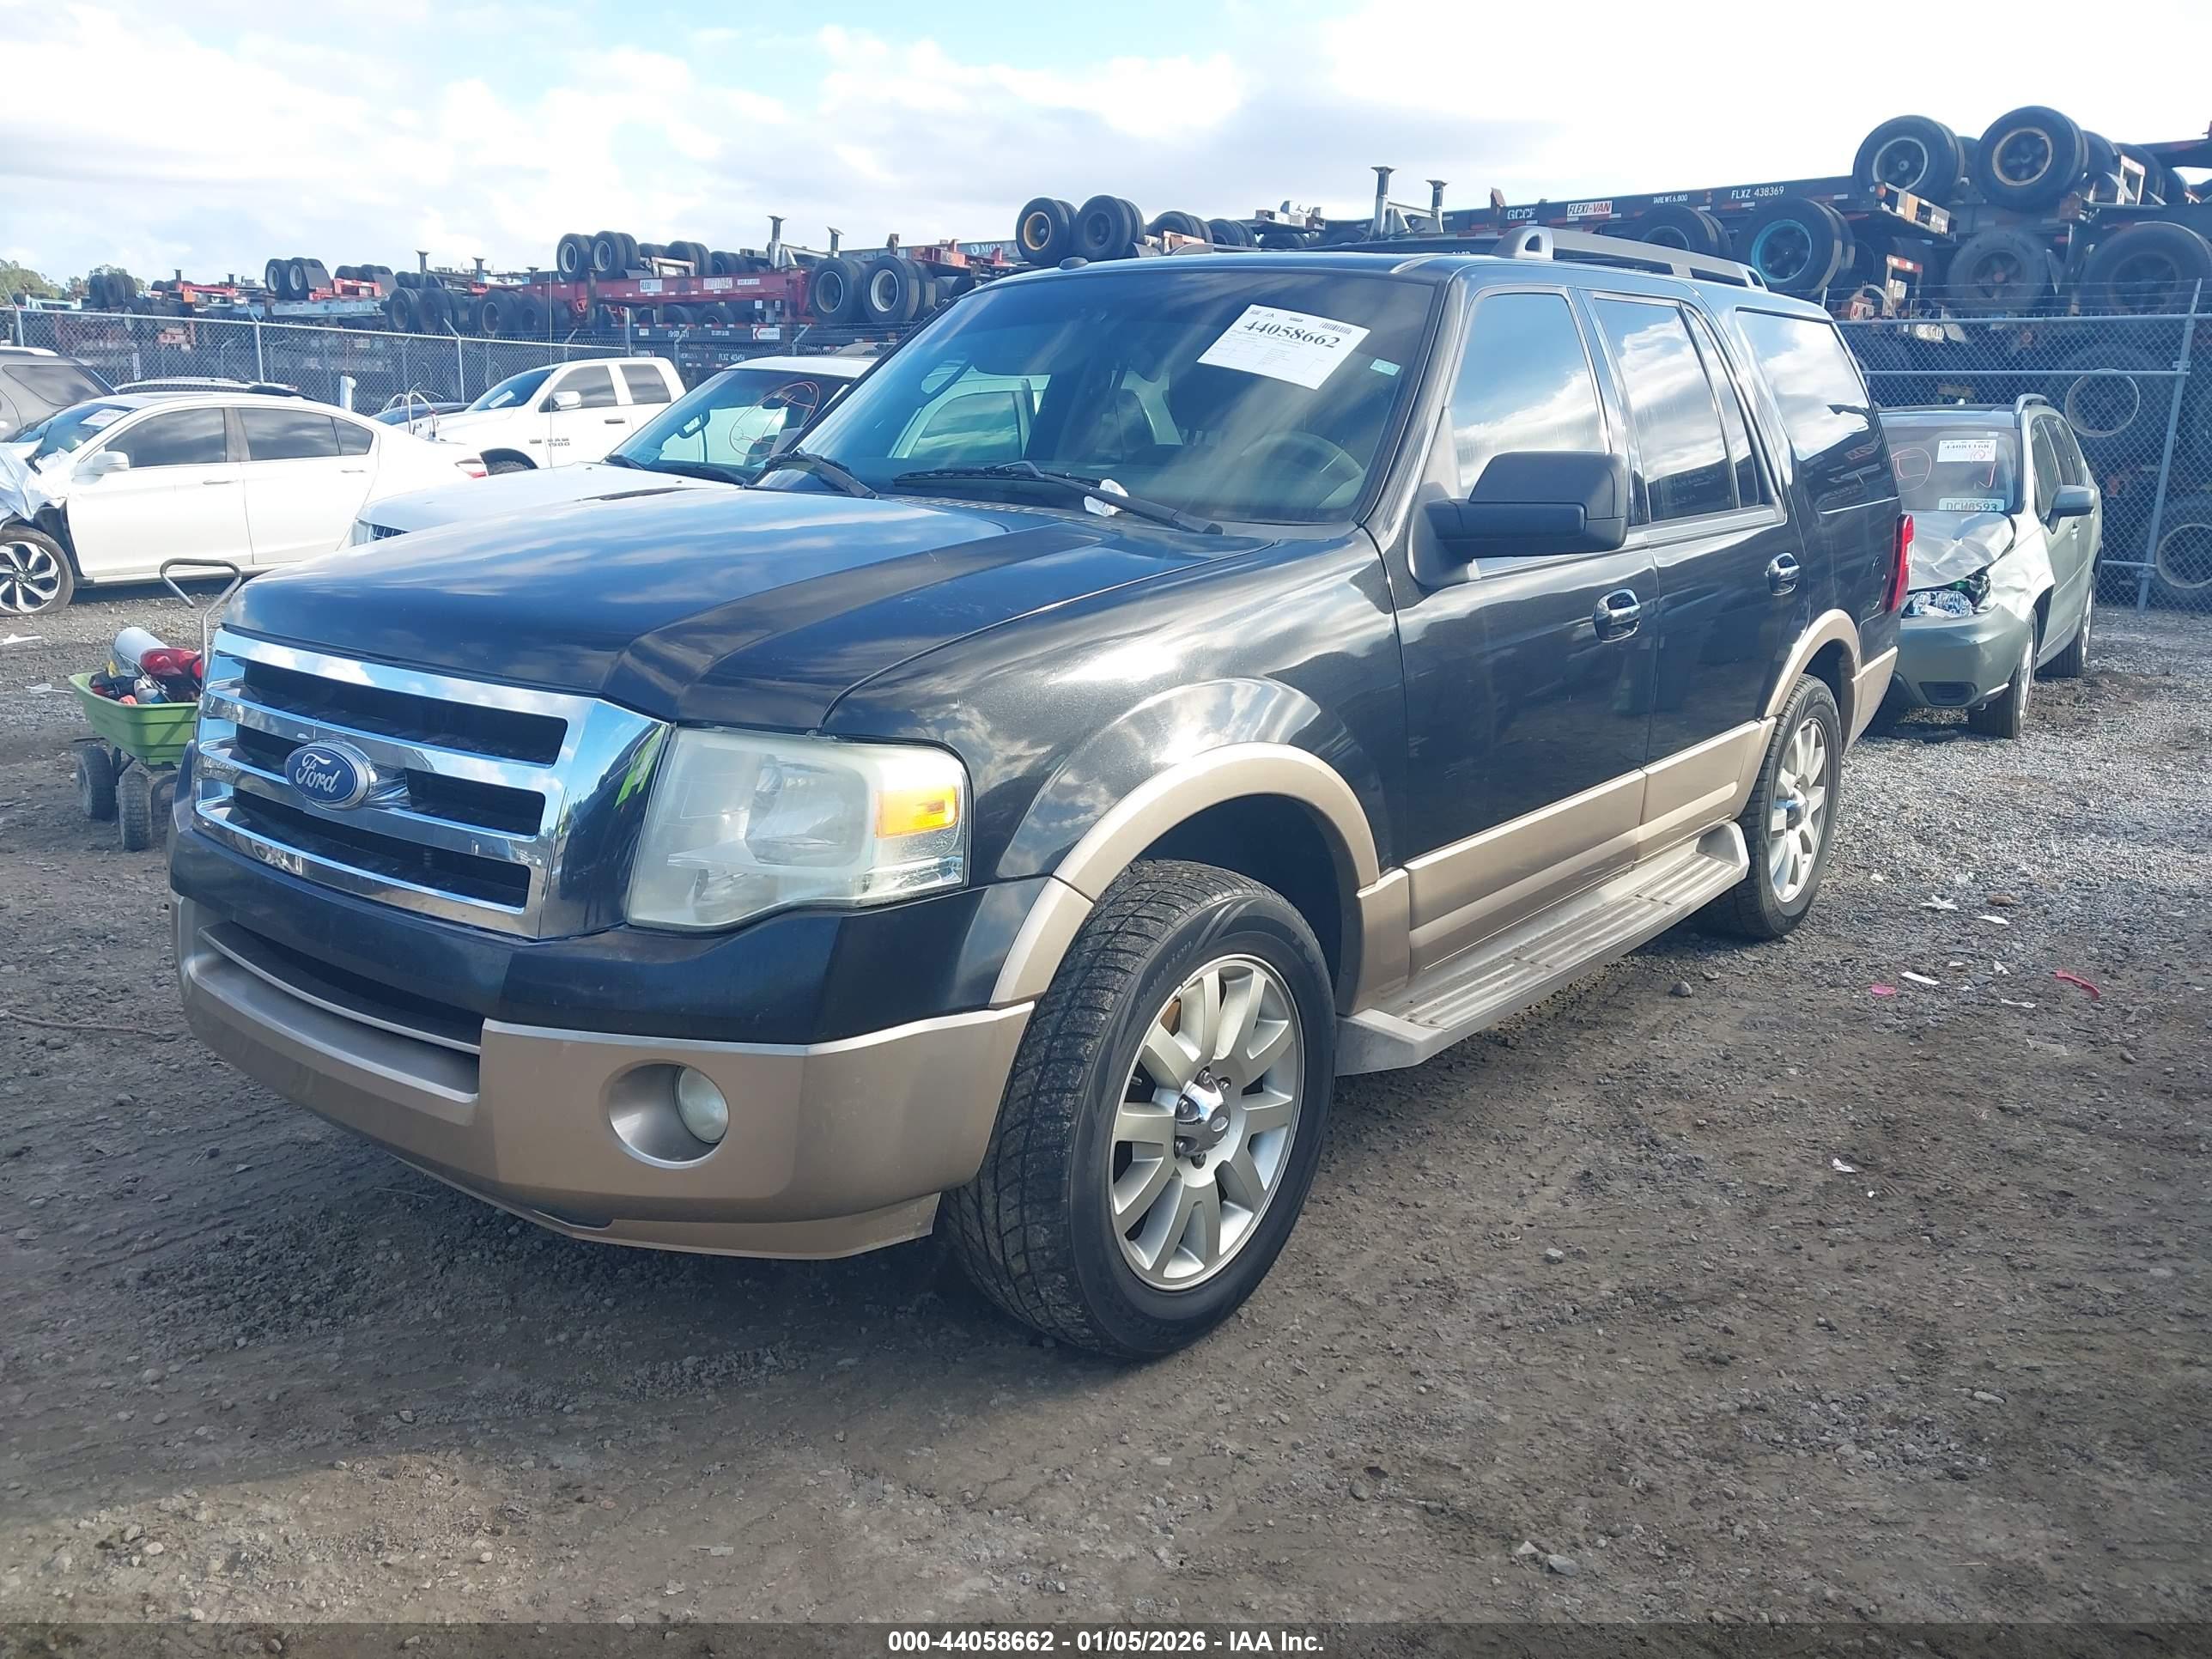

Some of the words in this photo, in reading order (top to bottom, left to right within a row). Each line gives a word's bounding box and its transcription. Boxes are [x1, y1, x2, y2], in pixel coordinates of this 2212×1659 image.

[1731, 189, 1751, 199] FLXZ
[1753, 185, 1784, 197] 438369
[1567, 202, 1611, 216] FLEXI-VAN
[1243, 319, 1340, 349] 44058662
[295, 753, 341, 793] Ford
